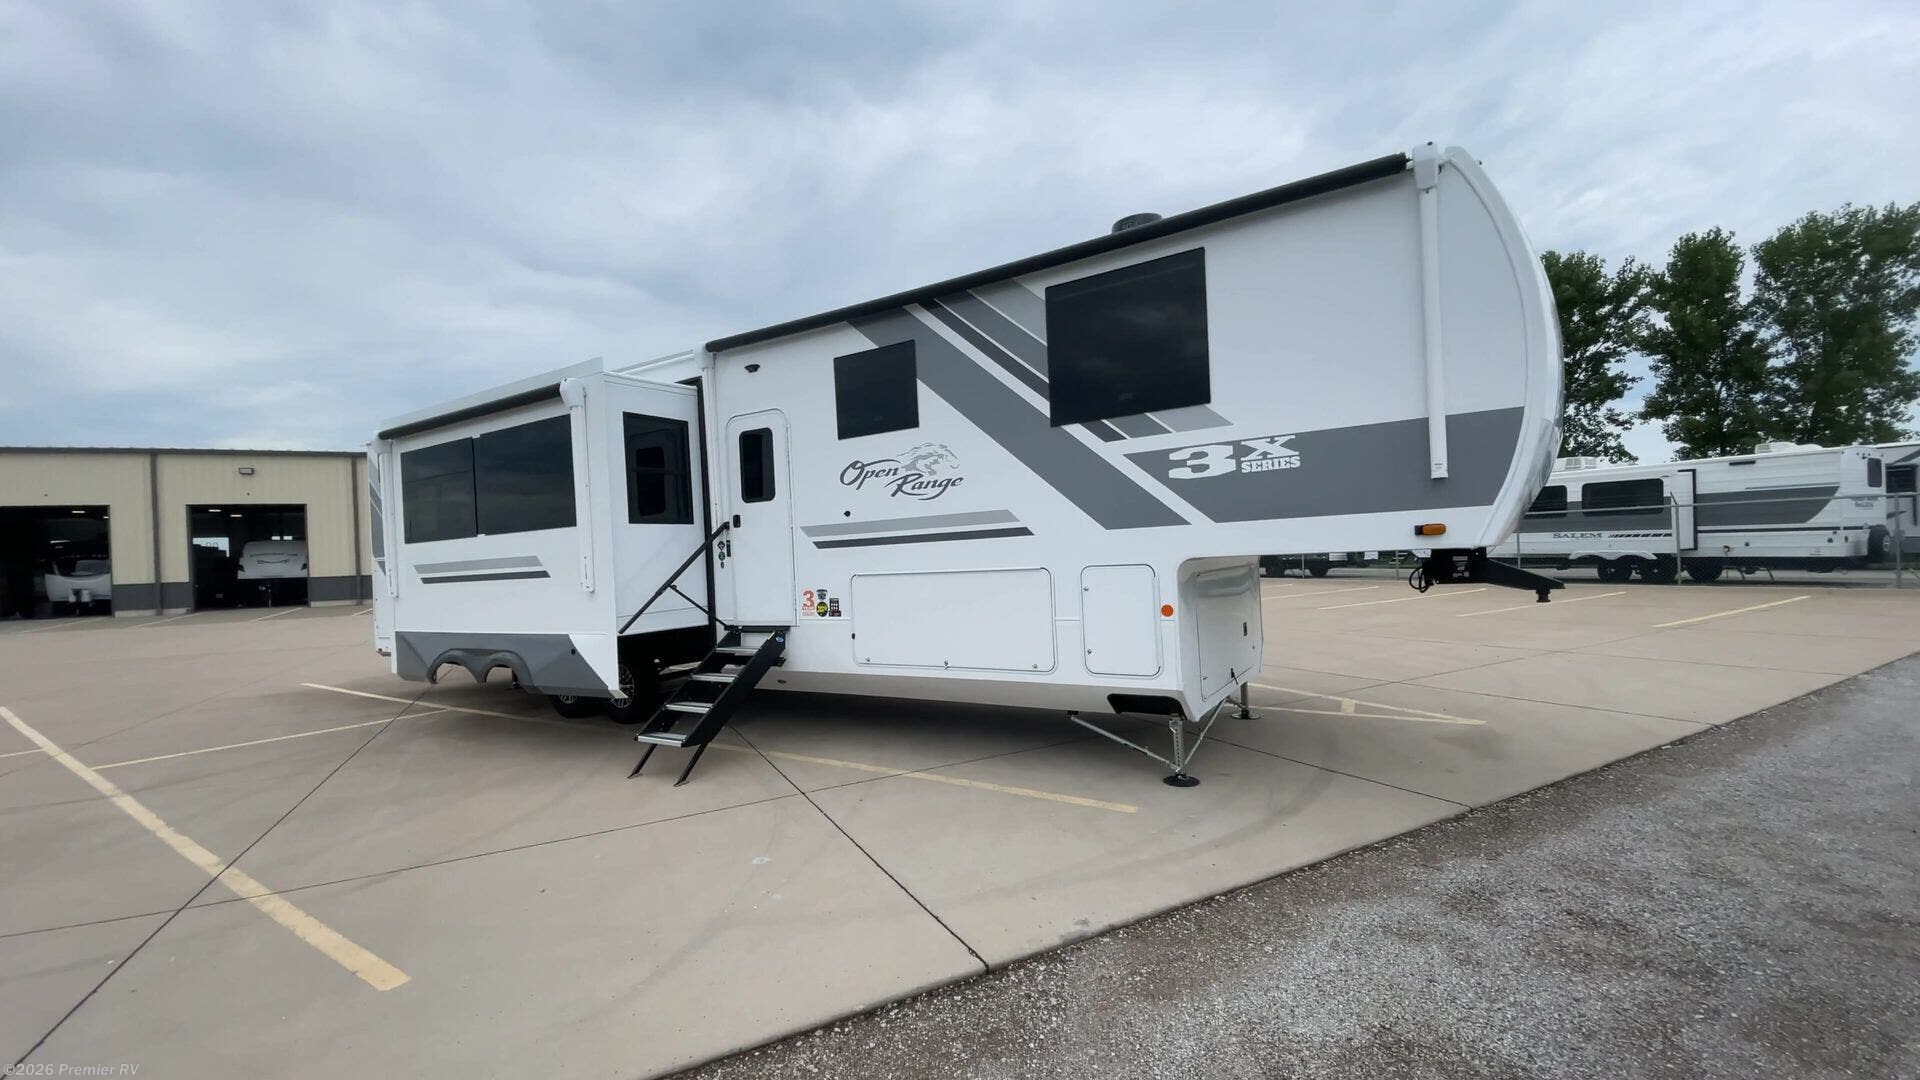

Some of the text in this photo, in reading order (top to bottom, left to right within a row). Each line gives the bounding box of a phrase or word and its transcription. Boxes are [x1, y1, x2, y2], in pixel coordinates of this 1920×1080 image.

[840, 458, 901, 491] Open
[1241, 456, 1301, 473] SERIES
[884, 472, 963, 501] Range
[802, 590, 815, 607] 3
